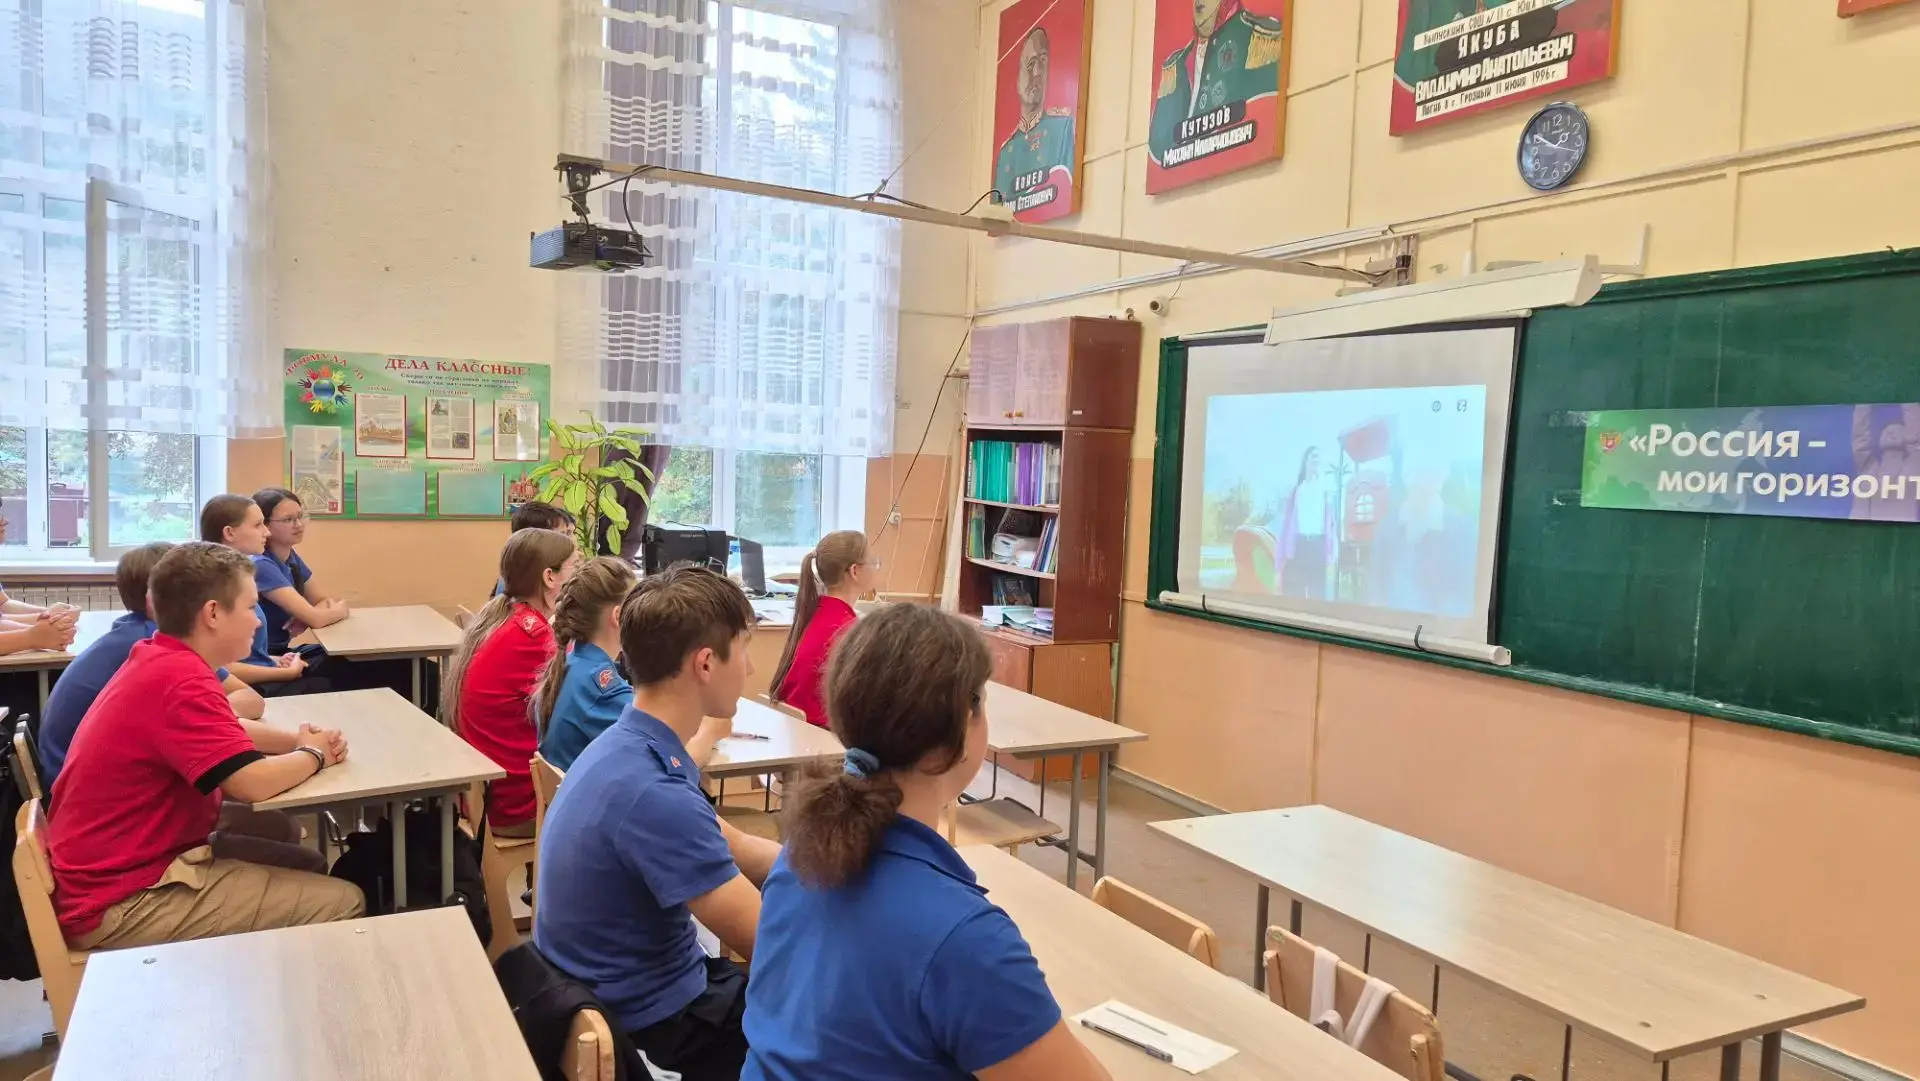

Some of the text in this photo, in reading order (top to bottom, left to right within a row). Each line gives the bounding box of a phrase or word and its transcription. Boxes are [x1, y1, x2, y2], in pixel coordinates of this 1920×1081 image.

[1458, 20, 1520, 59] ЯКУБА
[385, 358, 430, 371] ДЕЛА
[1628, 423, 1800, 458] «Россия
[1656, 469, 1728, 494] мои
